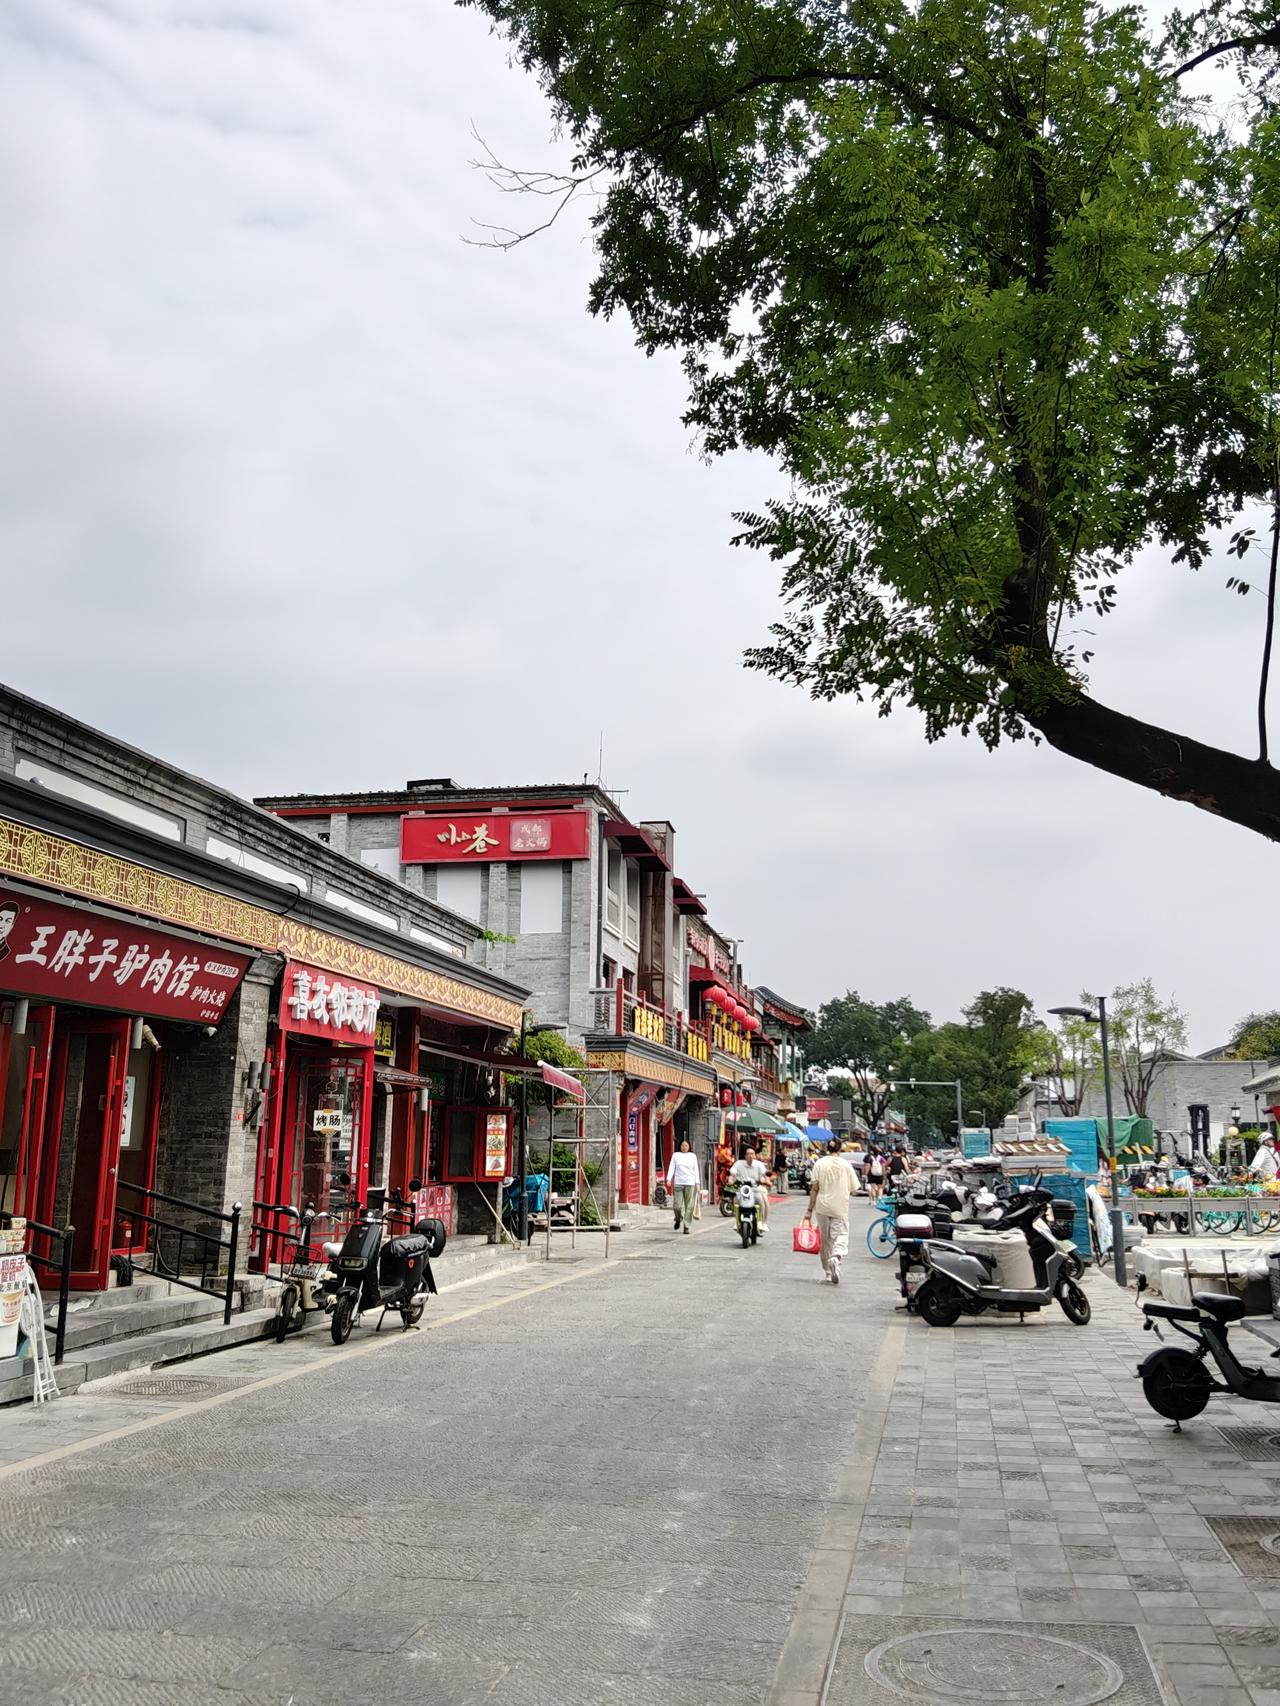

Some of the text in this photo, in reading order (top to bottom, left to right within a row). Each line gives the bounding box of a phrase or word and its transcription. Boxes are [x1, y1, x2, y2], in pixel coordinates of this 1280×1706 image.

[15, 925, 200, 998] 王胖子驴肉馆
[190, 985, 227, 1007] 驴肉火烧
[315, 1114, 341, 1127] 烤肠
